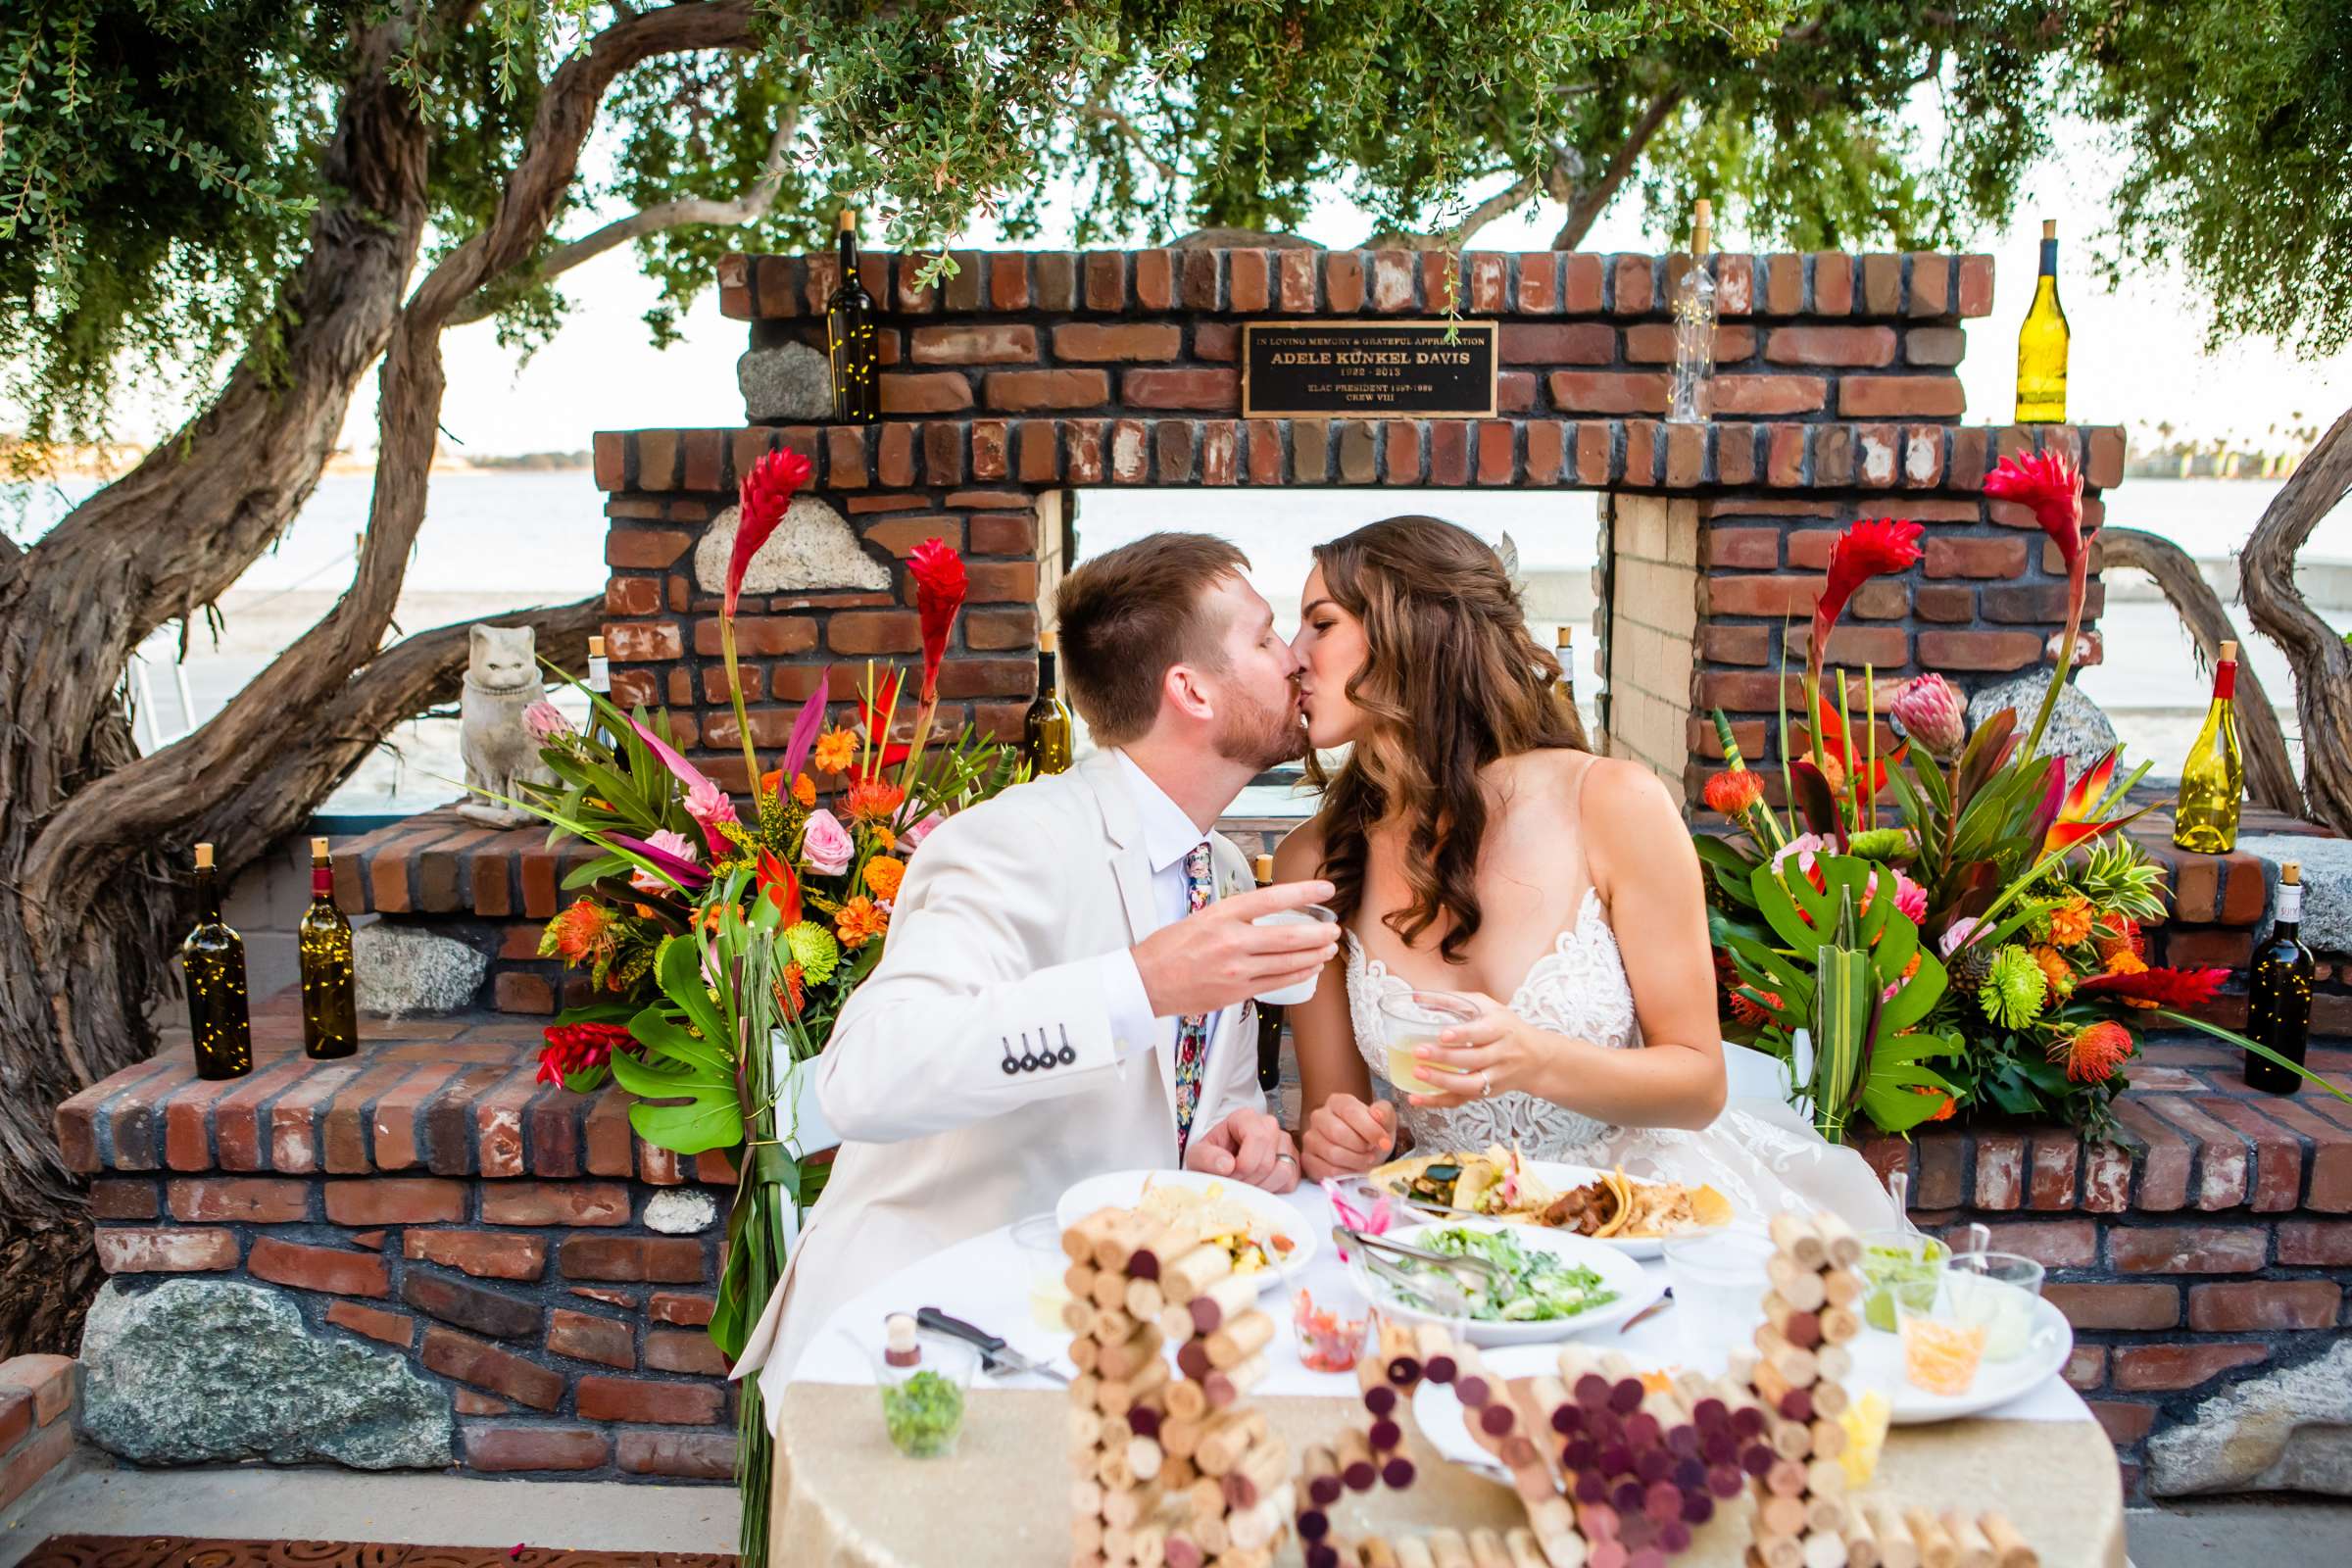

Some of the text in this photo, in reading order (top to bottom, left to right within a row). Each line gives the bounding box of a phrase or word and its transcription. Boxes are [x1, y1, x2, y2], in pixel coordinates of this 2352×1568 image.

[1271, 353, 1332, 365] ADELE
[1415, 353, 1471, 365] DAVIS
[1335, 383, 1389, 392] PRESIDENT
[1346, 393, 1395, 402] CREW VIII
